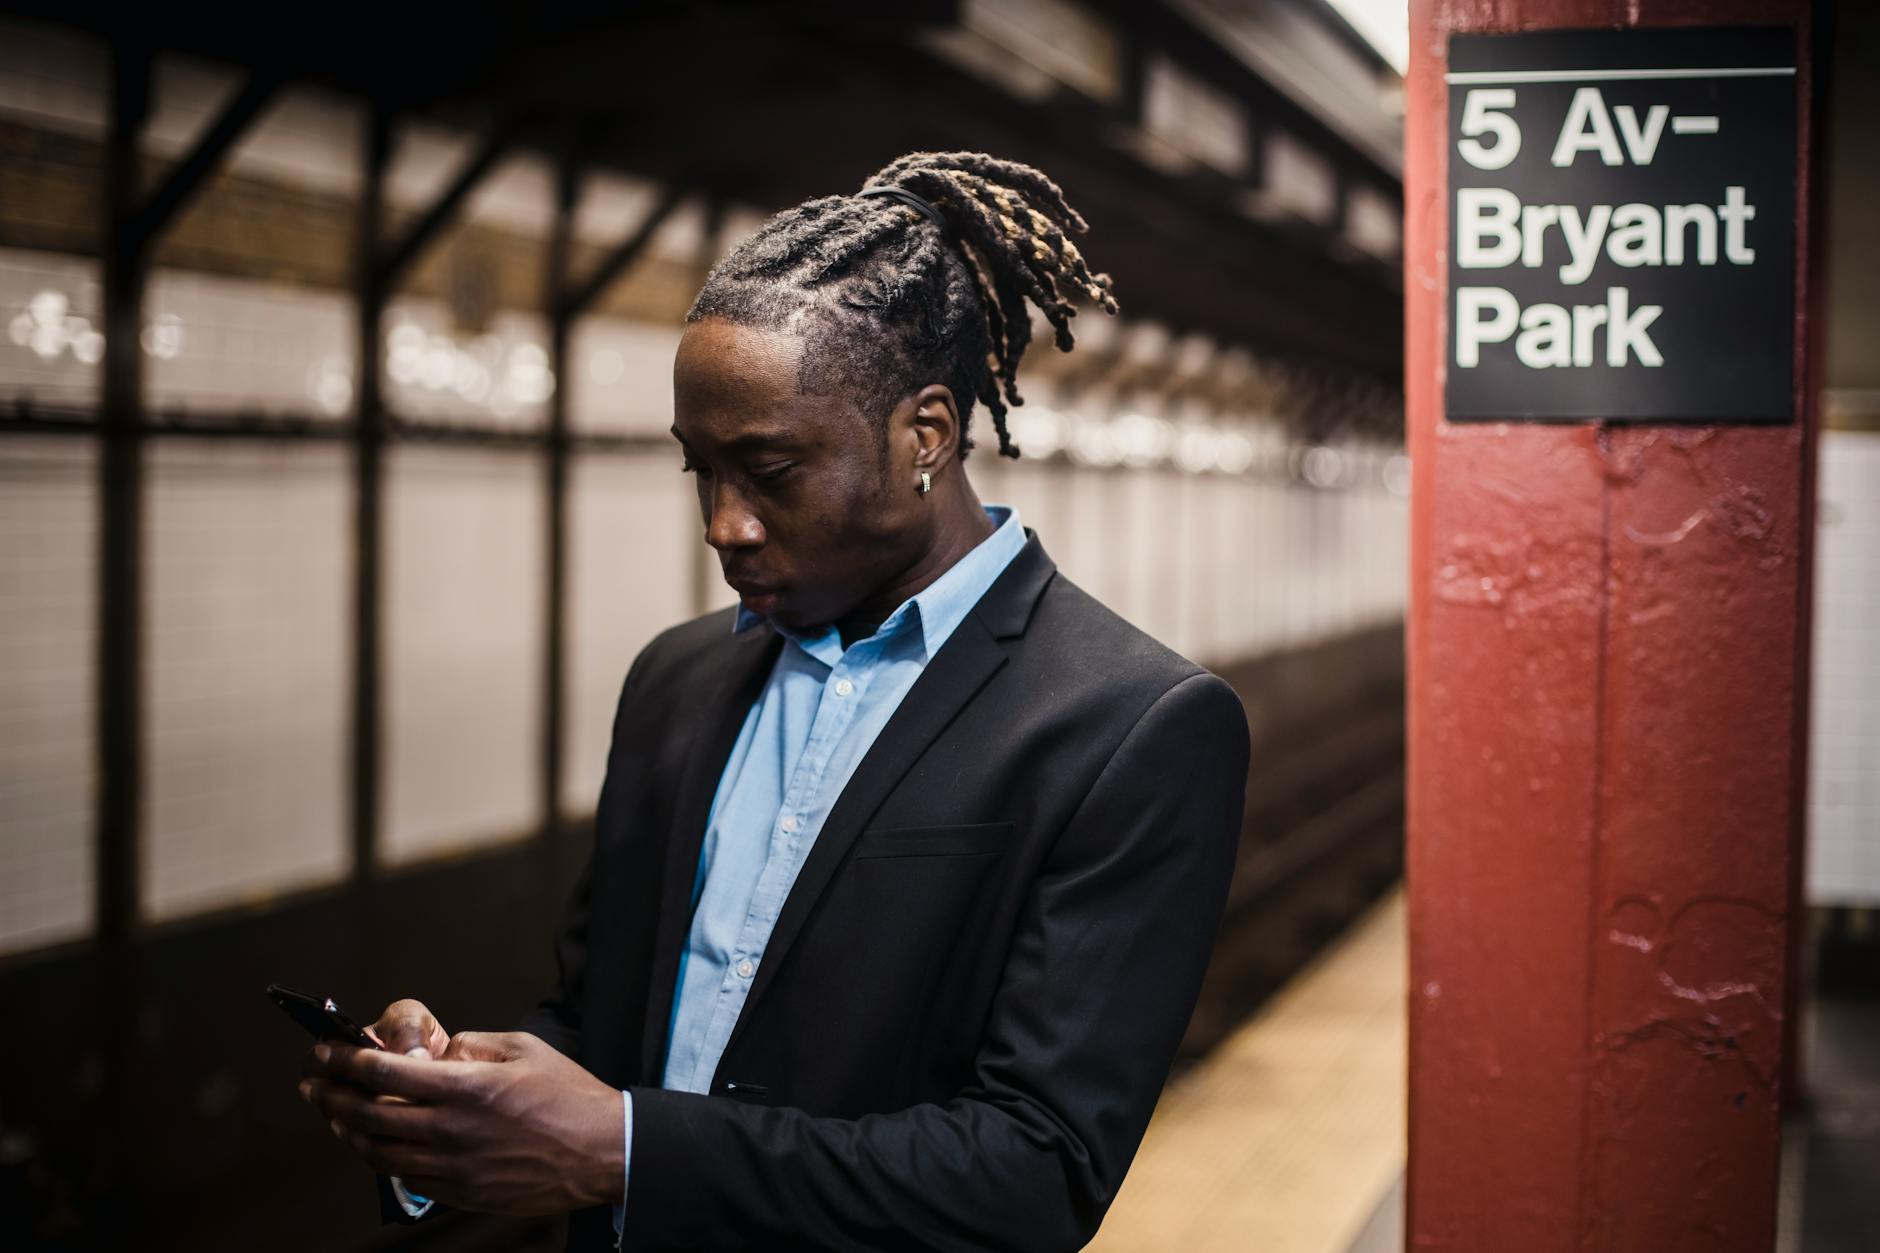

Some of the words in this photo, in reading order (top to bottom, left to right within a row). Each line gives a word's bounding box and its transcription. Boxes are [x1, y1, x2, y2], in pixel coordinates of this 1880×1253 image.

[1456, 88, 1522, 170] 5
[1550, 87, 1720, 167] Av-
[1456, 186, 1756, 286] Bryant
[1455, 286, 1665, 369] Park
